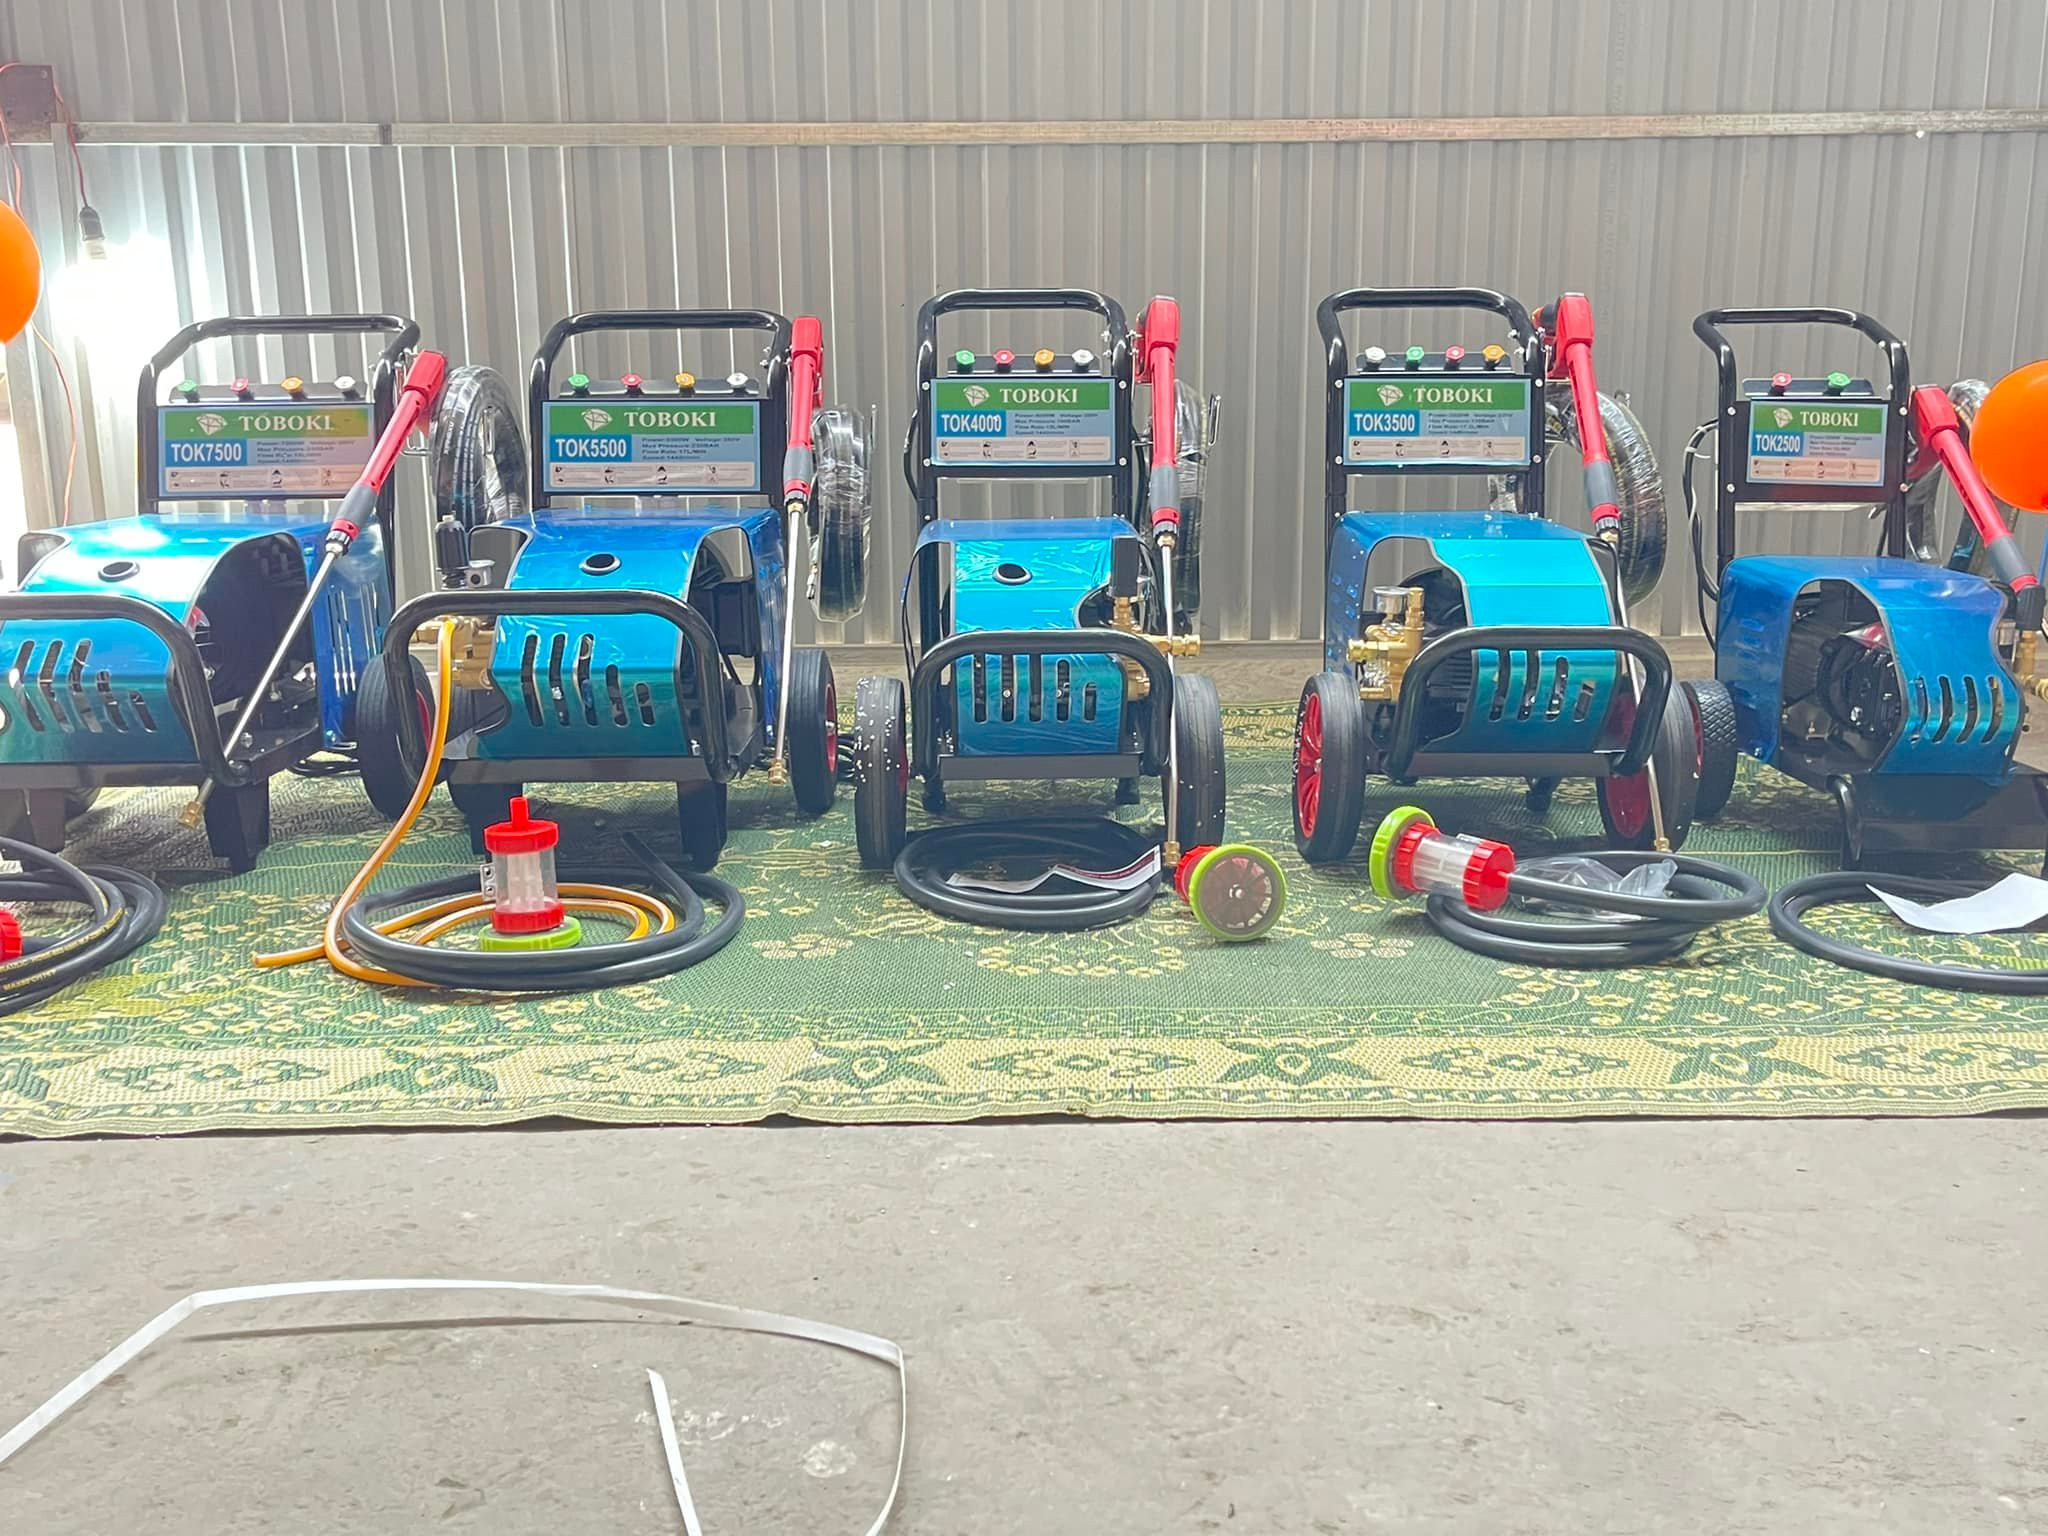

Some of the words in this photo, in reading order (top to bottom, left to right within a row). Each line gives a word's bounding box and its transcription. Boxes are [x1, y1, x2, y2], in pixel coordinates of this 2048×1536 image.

[999, 388, 1078, 404] TOBOKI
[1413, 388, 1493, 404] TOBOKI
[238, 415, 335, 432] TOBOKI
[624, 411, 716, 428] TOBOKI
[941, 414, 1002, 433] TOK4000
[1354, 413, 1415, 432] TOK3500
[1800, 411, 1859, 427] TOBOKI
[555, 438, 627, 458] TOK5500
[1755, 434, 1801, 453] TOK2500
[170, 443, 242, 463] TOK7500
